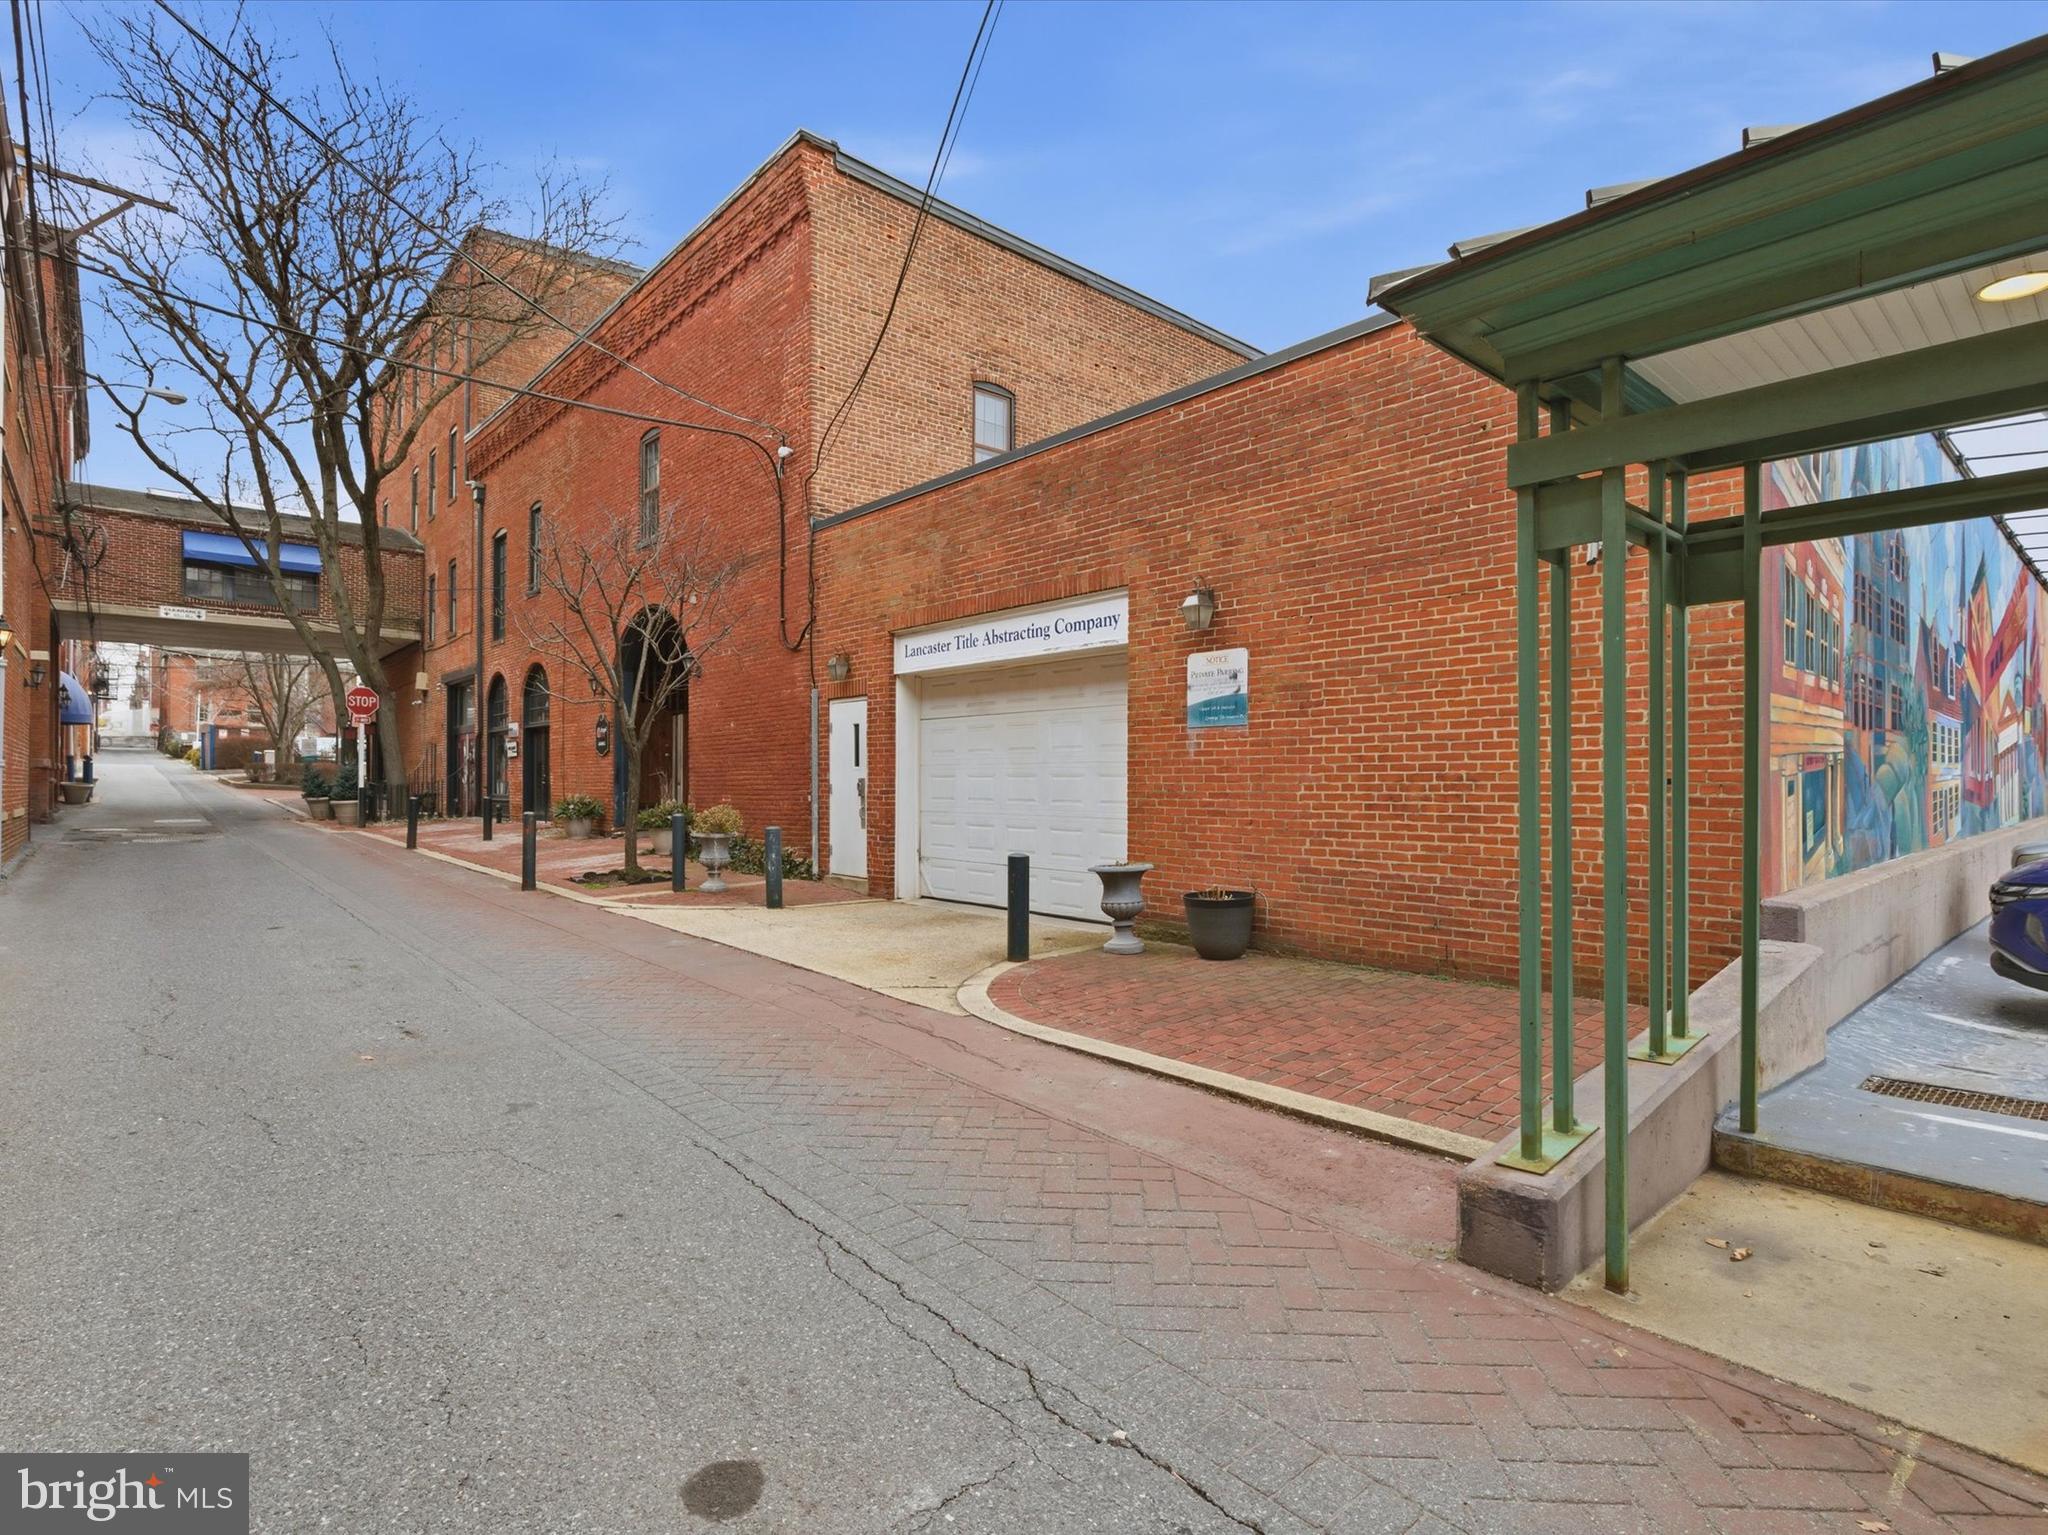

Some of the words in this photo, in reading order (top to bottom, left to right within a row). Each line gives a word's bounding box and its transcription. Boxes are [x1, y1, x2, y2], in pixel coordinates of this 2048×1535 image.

[904, 641, 952, 659] Lancaster
[953, 633, 979, 650] Title
[982, 623, 1051, 646] Abstracting
[1054, 613, 1121, 635] Company
[348, 695, 376, 707] STOP
